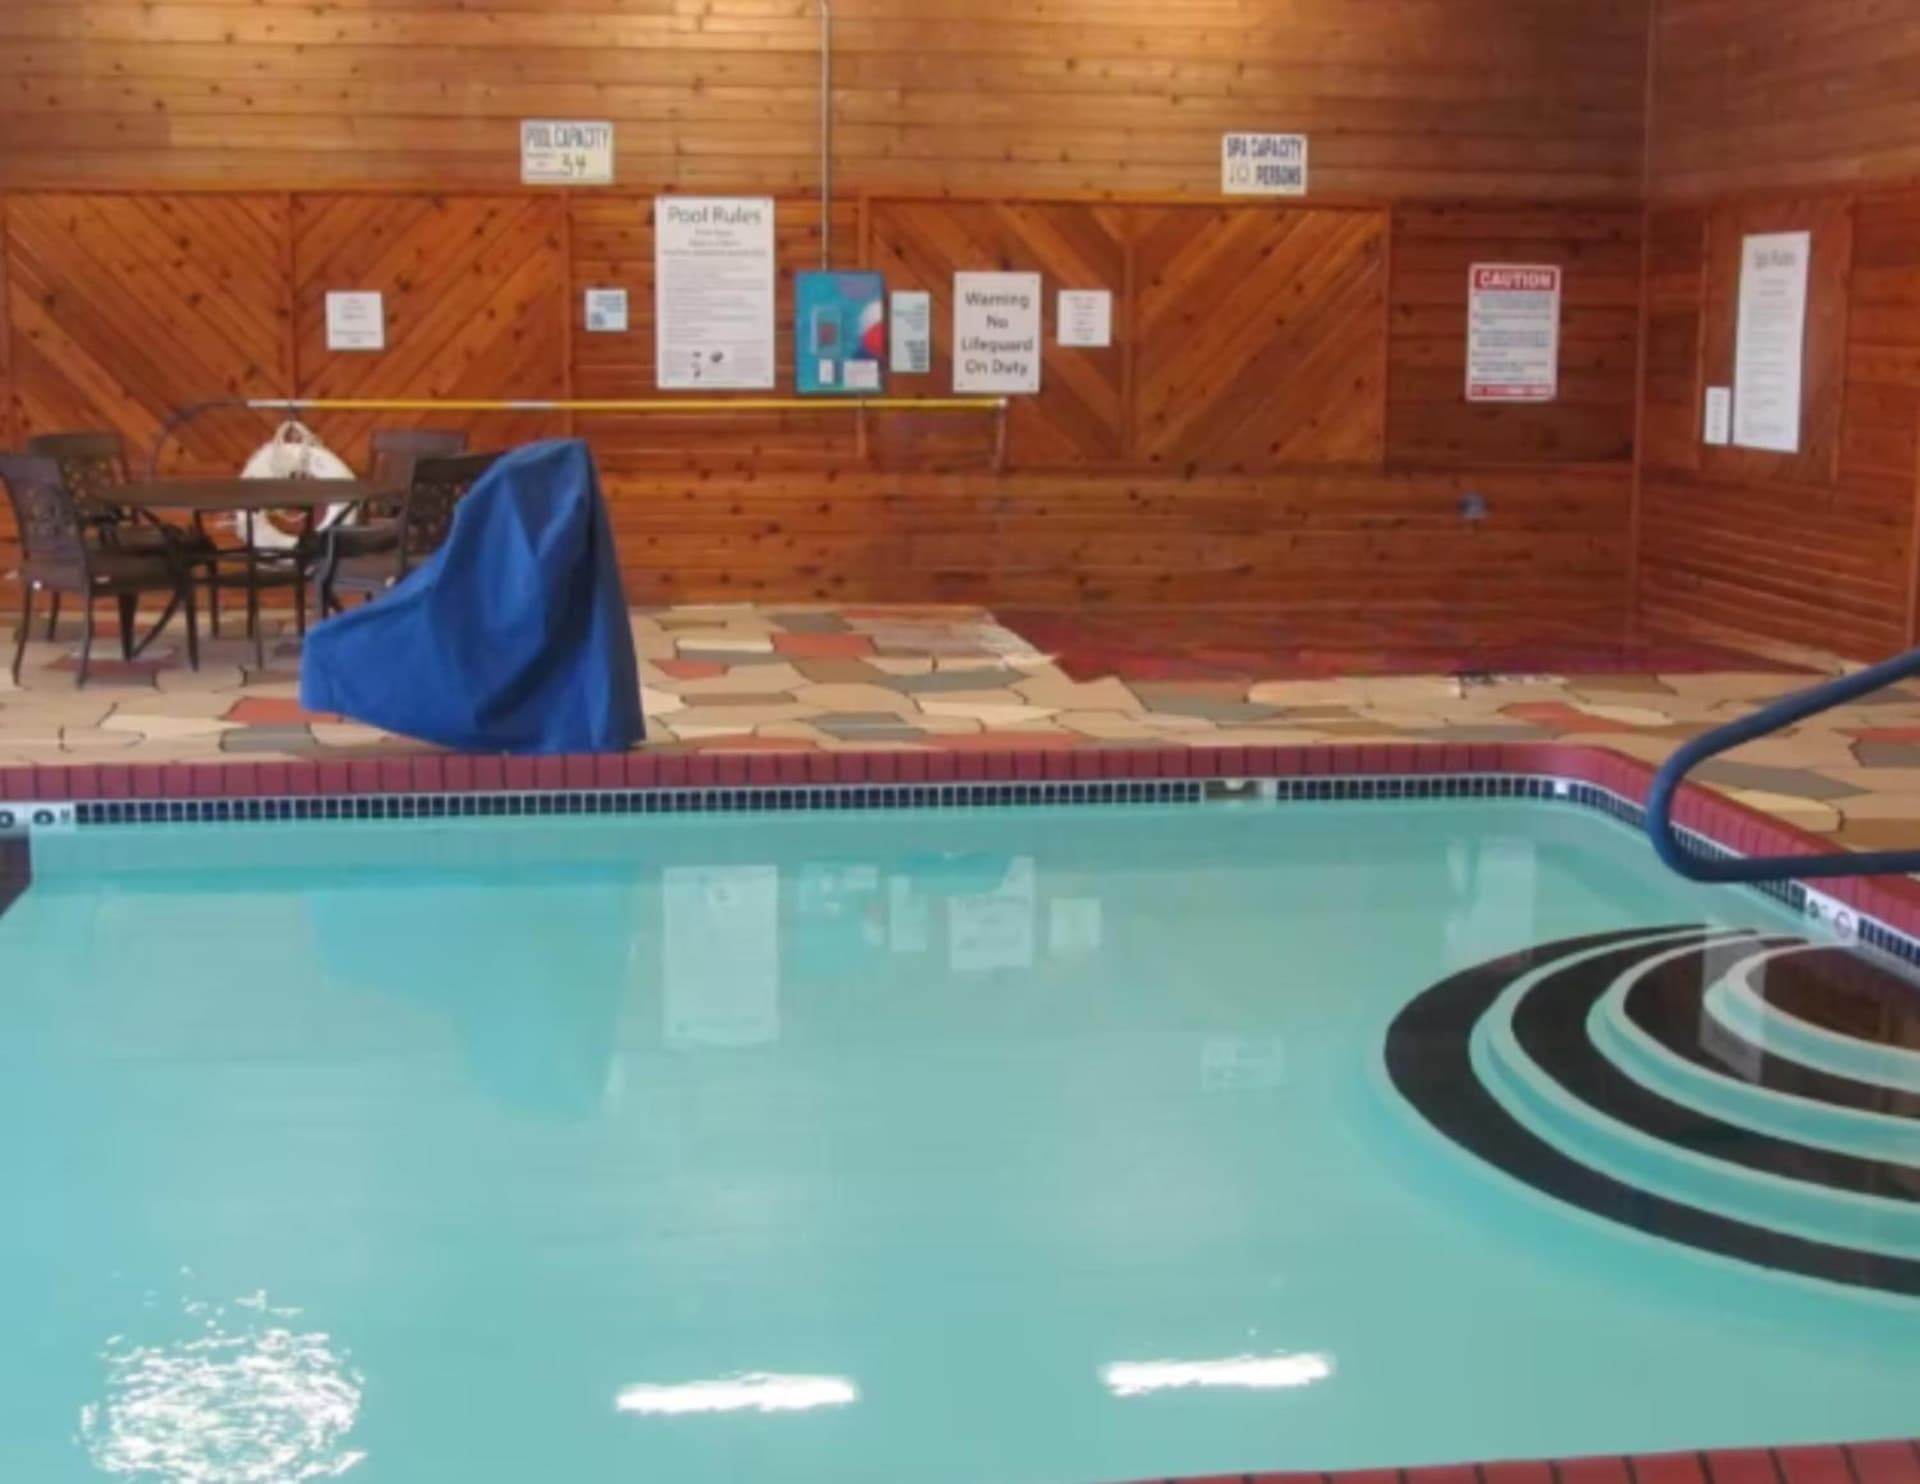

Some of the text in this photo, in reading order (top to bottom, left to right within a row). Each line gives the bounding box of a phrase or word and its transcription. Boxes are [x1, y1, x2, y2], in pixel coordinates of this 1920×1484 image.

[667, 206, 762, 225] Pool Rules
[1480, 271, 1552, 288] CAUTION
[965, 291, 1030, 310] Warning
[986, 315, 1009, 329] No
[961, 337, 1033, 354] Lifeguard
[965, 359, 1028, 377] On Duty
